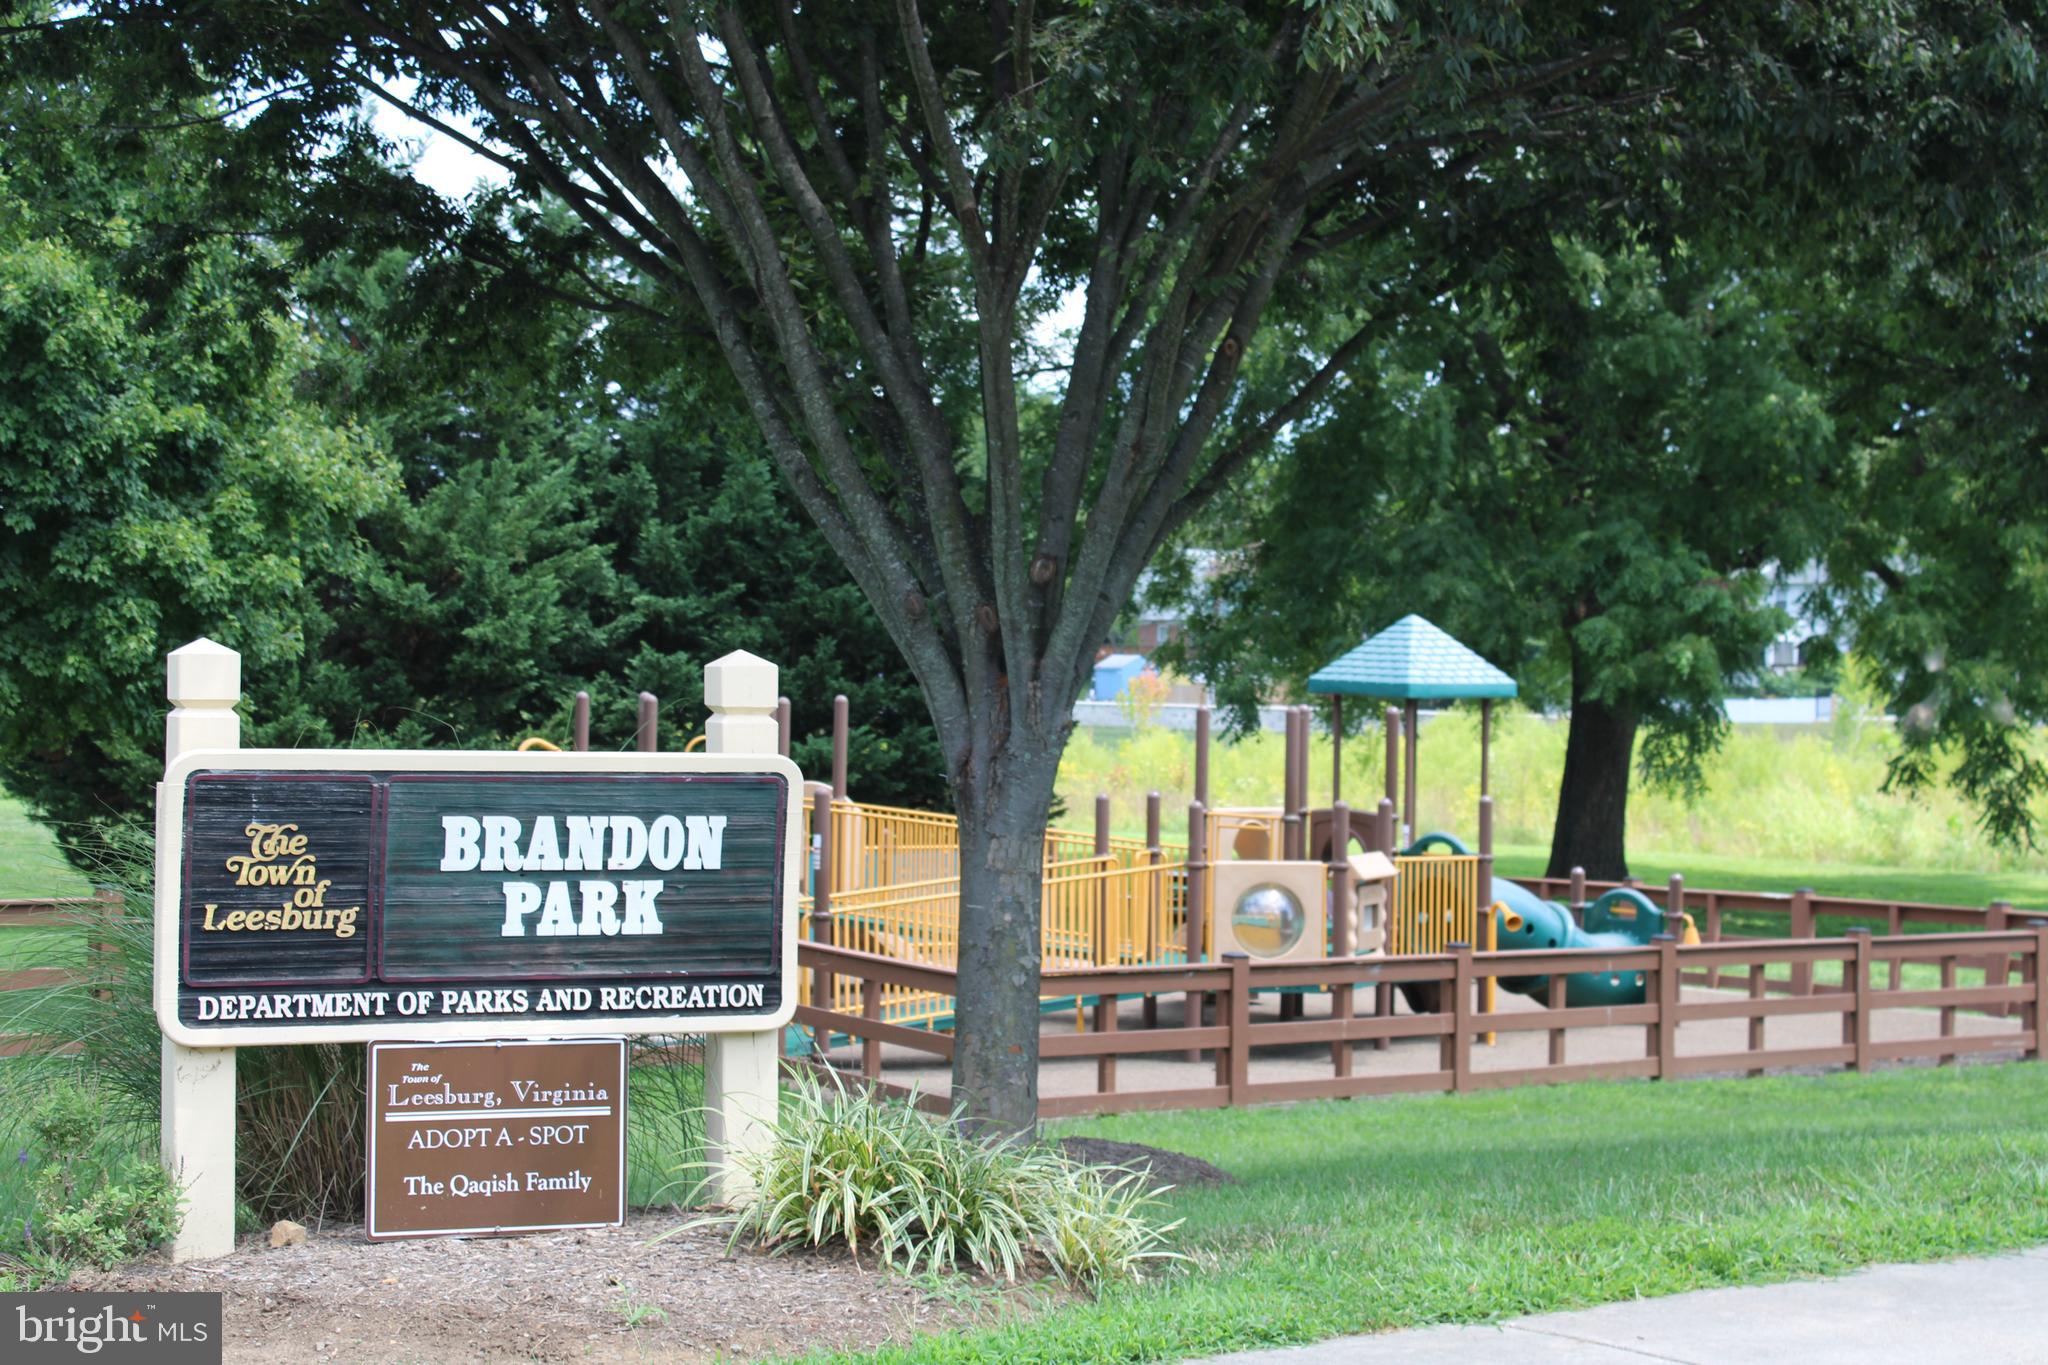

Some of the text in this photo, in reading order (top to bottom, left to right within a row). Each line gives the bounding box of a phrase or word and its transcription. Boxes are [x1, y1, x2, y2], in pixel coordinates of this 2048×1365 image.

[245, 822, 308, 861] The
[440, 815, 727, 872] BRANDON
[226, 855, 316, 886] Town
[294, 880, 331, 907] of
[501, 880, 664, 936] PARK
[203, 902, 360, 938] Leesburg
[198, 984, 764, 1020] DEPARTMENT OF PARKS AND RECREATION
[402, 1074, 443, 1084] Town of
[411, 1062, 429, 1072] The
[388, 1080, 608, 1108] Leesburg, Virginia
[408, 1128, 492, 1149] ADOPT
[403, 1169, 592, 1197] The Qaqish Family
